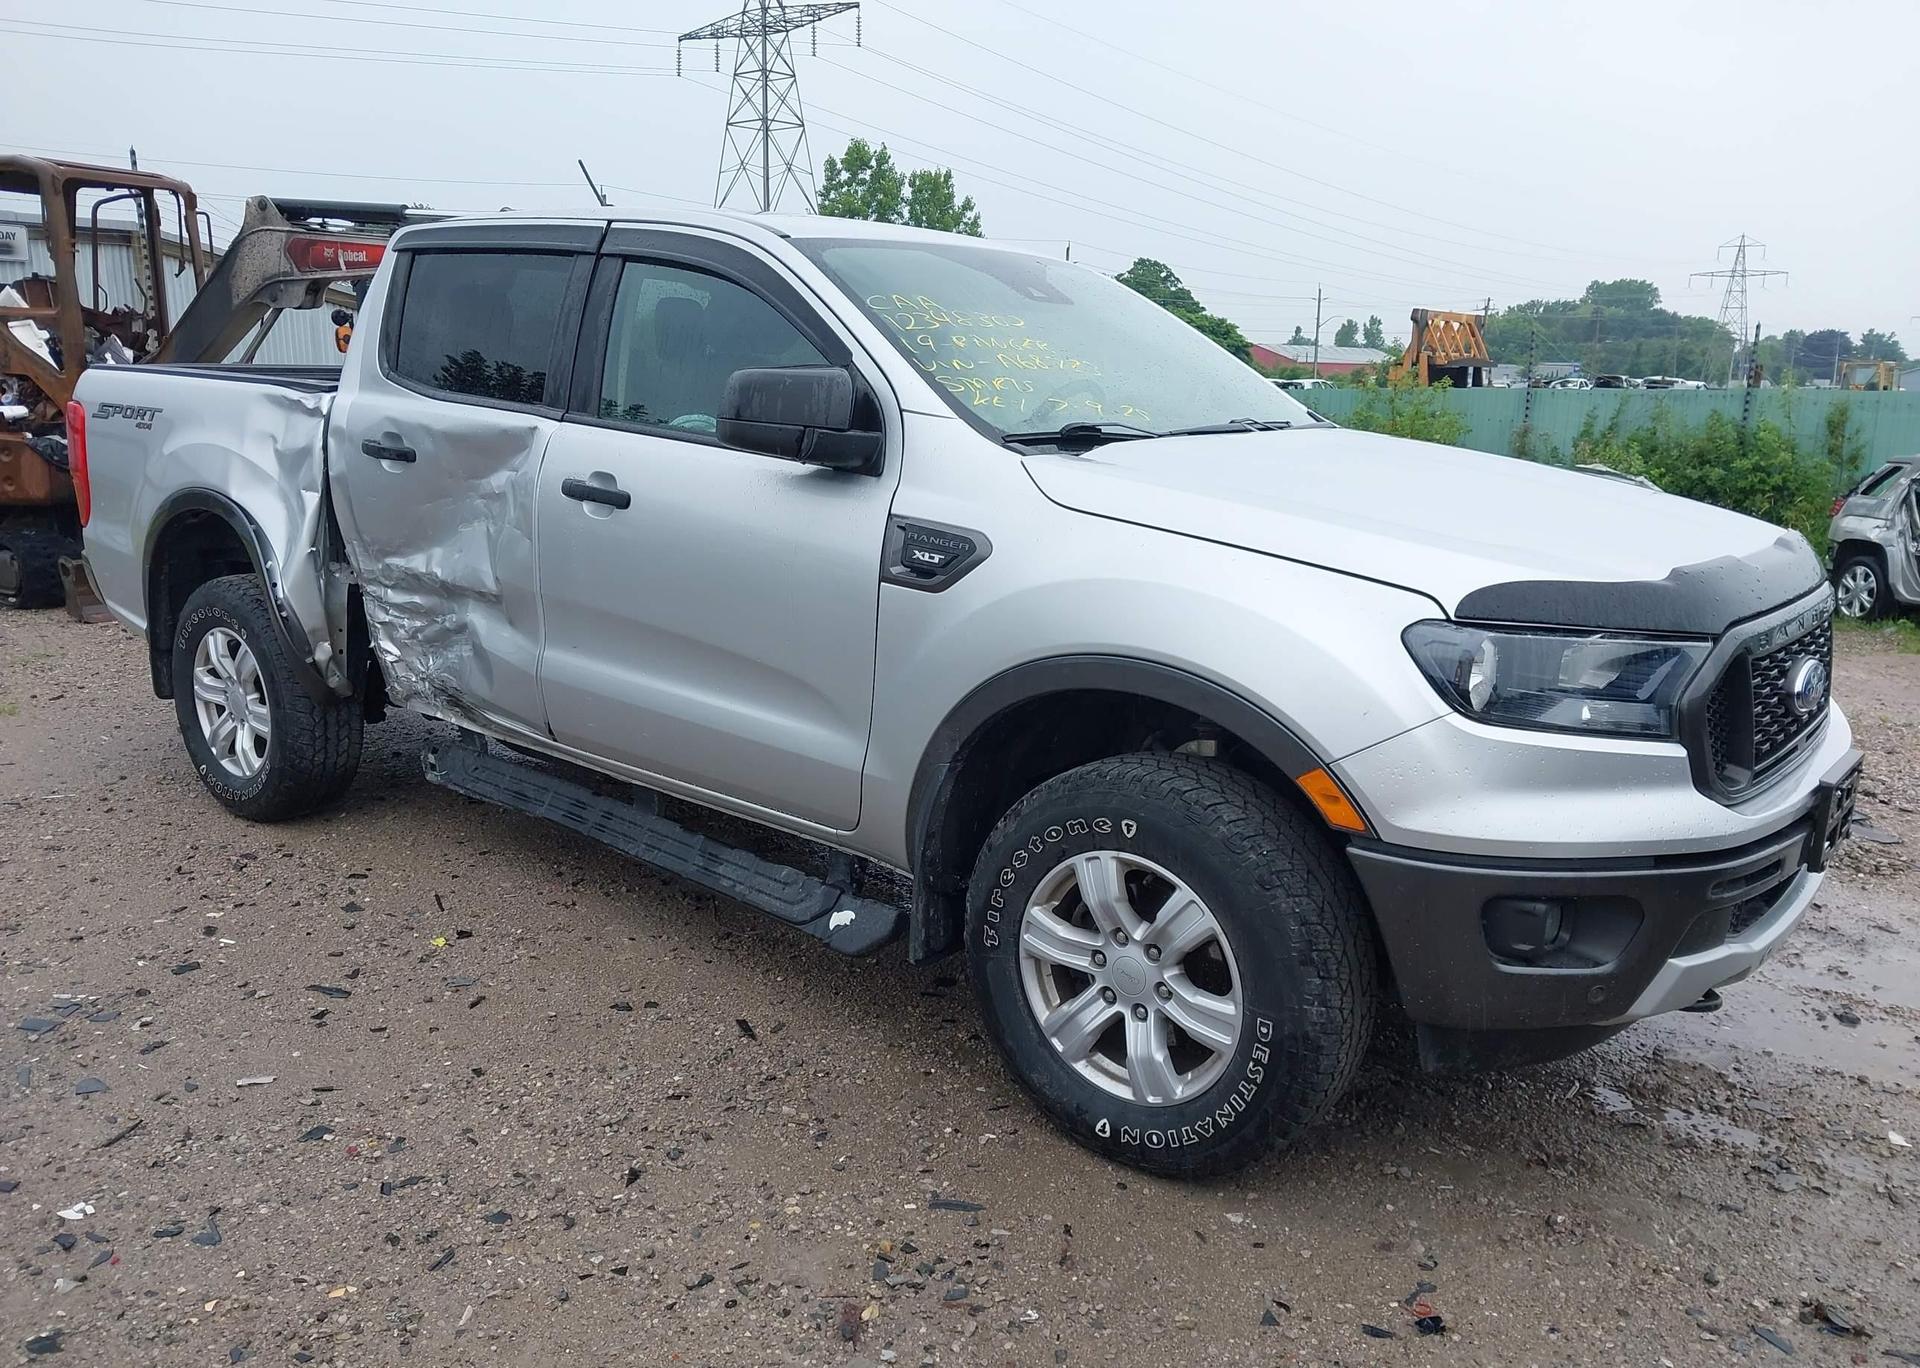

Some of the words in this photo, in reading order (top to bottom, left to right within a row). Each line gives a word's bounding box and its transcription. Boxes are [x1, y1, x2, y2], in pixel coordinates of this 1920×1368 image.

[866, 294, 945, 311] CAA
[92, 402, 164, 422] SPORT
[907, 532, 970, 551] RANGER
[911, 549, 945, 564] XLT
[983, 817, 1113, 947] Firestone
[1121, 1017, 1274, 1149] DESTINATION
